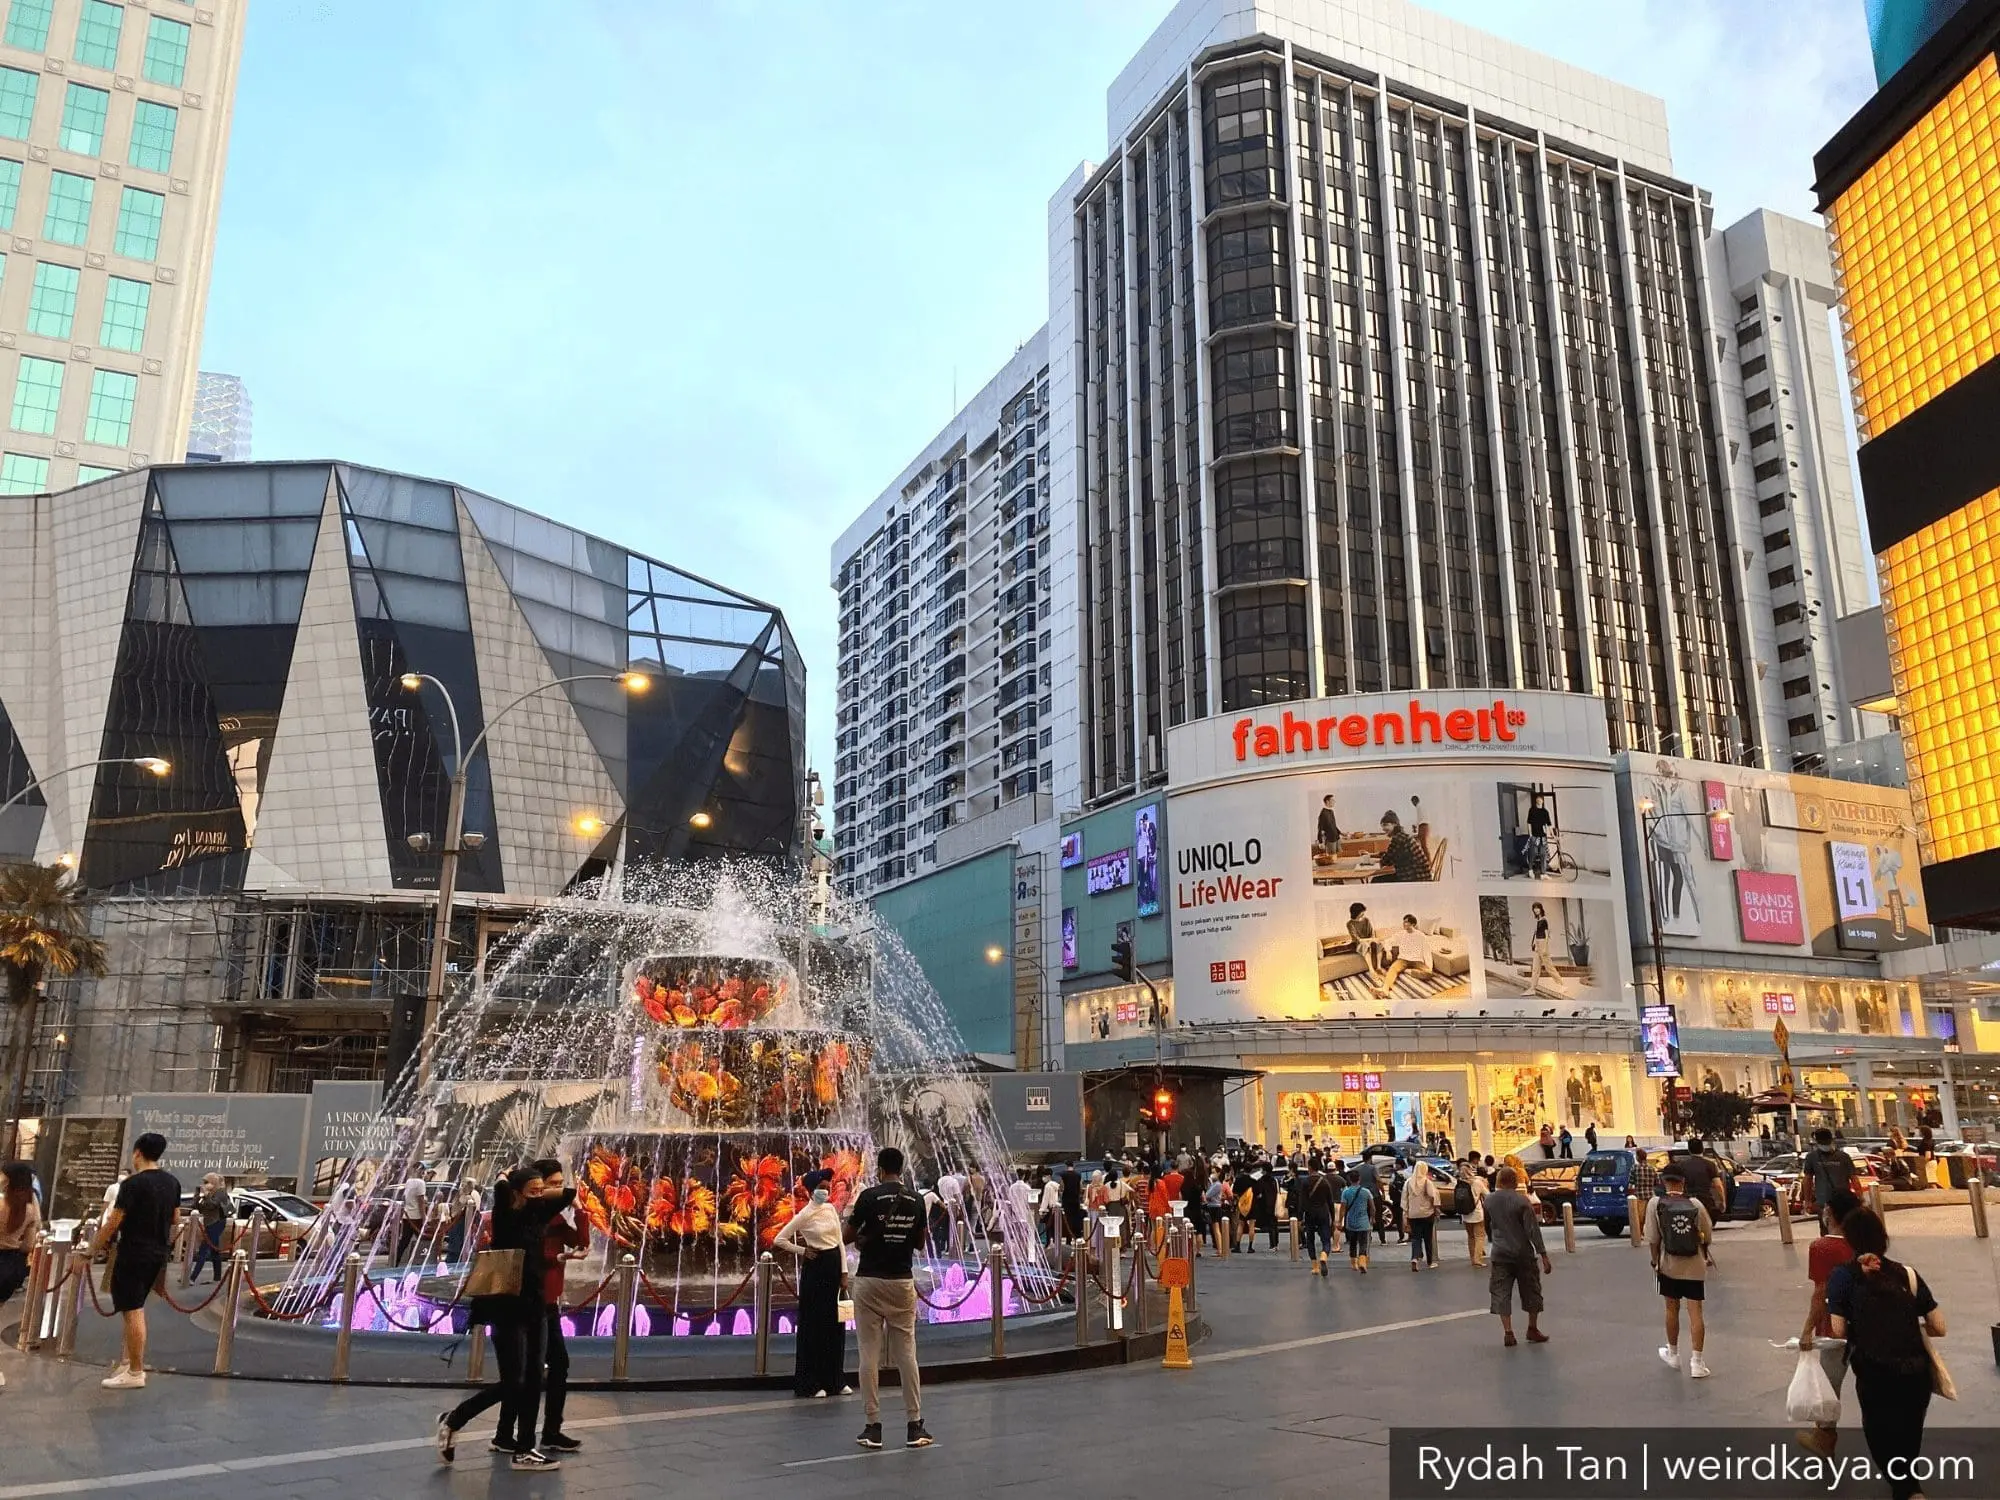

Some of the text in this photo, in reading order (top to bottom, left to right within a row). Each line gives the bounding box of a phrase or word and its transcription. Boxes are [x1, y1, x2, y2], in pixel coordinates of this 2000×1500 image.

[1232, 700, 1516, 761] fahrenheit
[1178, 838, 1262, 875] UNIQLO
[1178, 874, 1284, 909] LifeWear
[1744, 890, 1794, 908] BRANDS
[1842, 876, 1868, 907] L1
[1748, 906, 1794, 925] OUTLET
[1231, 962, 1244, 972] UNI
[1231, 971, 1245, 980] QLO
[182, 1114, 195, 1124] so
[197, 1113, 226, 1128] great
[324, 1112, 332, 1123] A
[174, 1126, 233, 1142] inspiration
[236, 1126, 246, 1138] is
[201, 1141, 208, 1152] it
[211, 1140, 239, 1153] finds
[243, 1144, 262, 1156] you
[322, 1140, 356, 1151] ATION
[169, 1156, 201, 1169] you're
[204, 1156, 222, 1168] not
